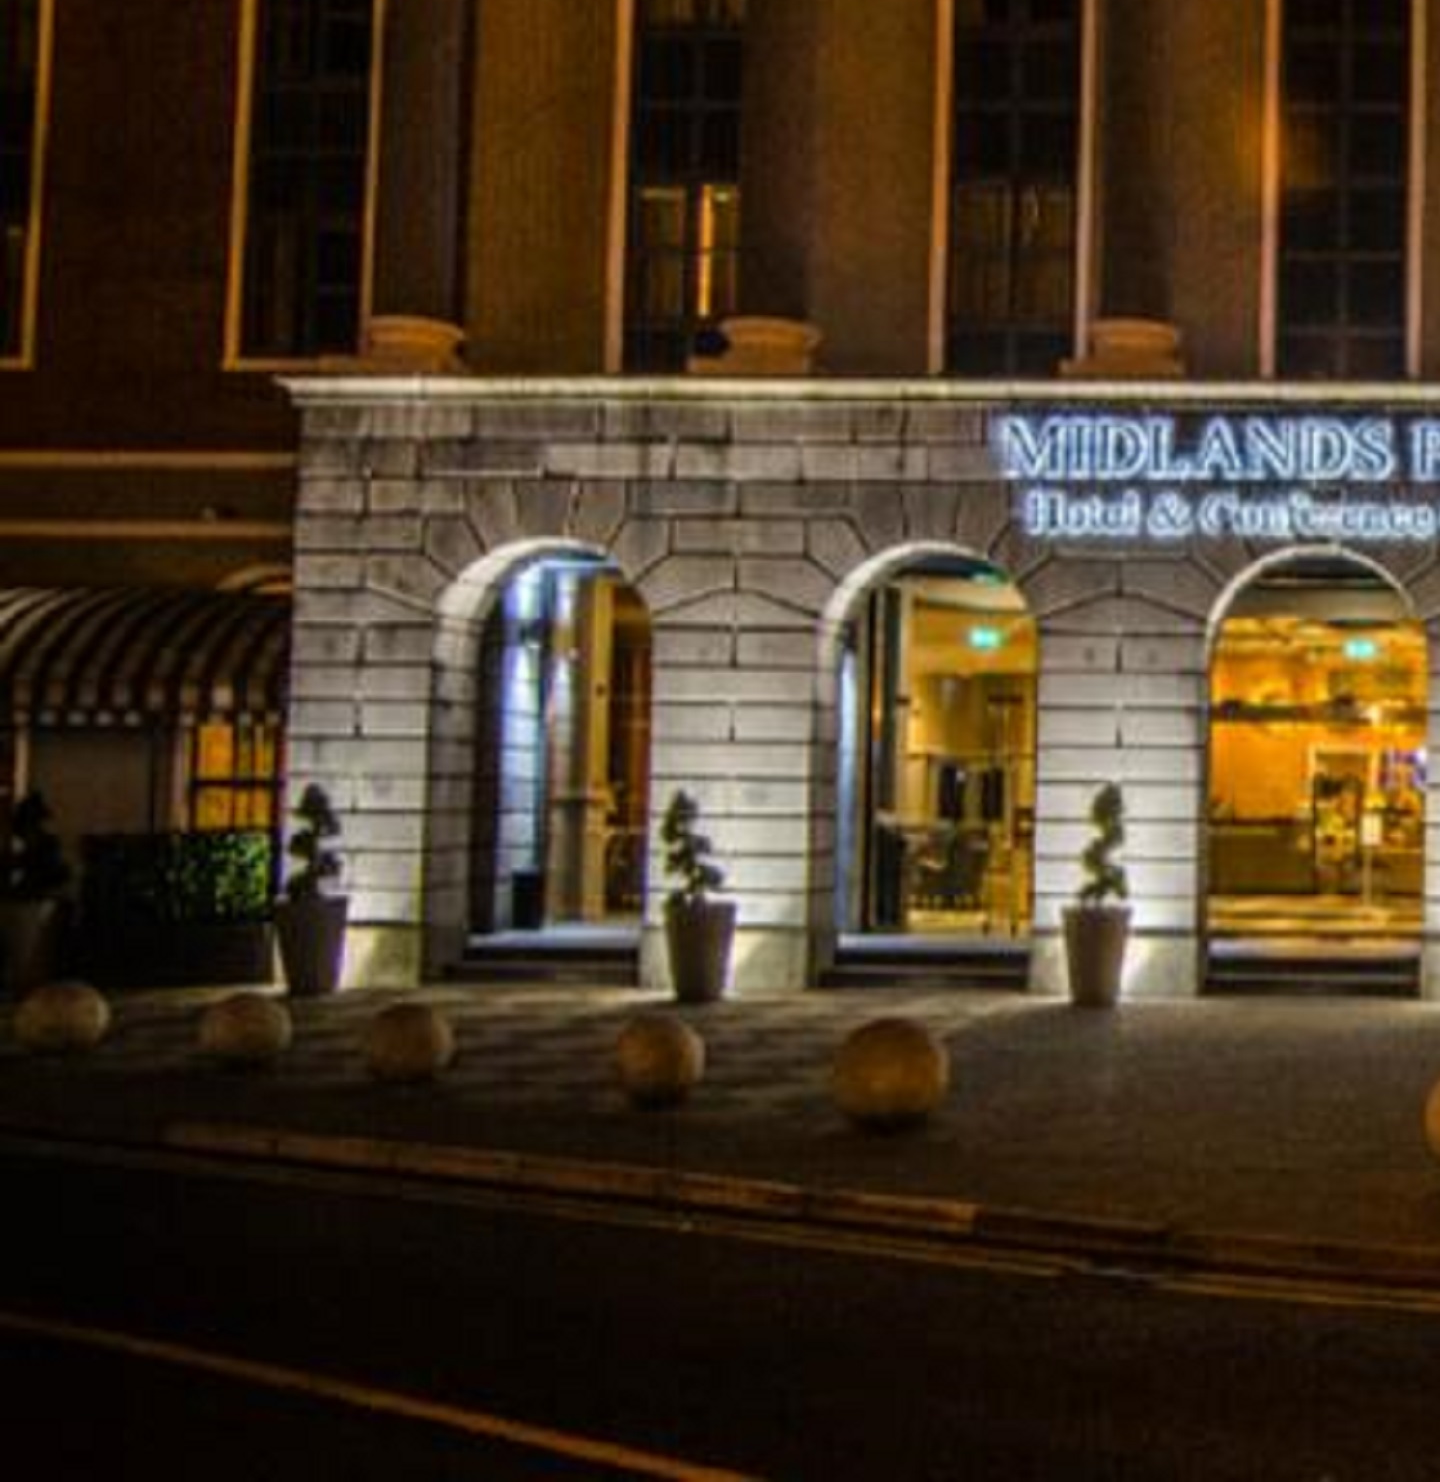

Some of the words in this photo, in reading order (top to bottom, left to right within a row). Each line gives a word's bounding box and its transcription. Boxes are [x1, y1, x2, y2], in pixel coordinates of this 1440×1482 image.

[1000, 415, 1397, 482] MIDLANDS
[1024, 488, 1141, 538] Hotel
[1147, 492, 1192, 540] &
